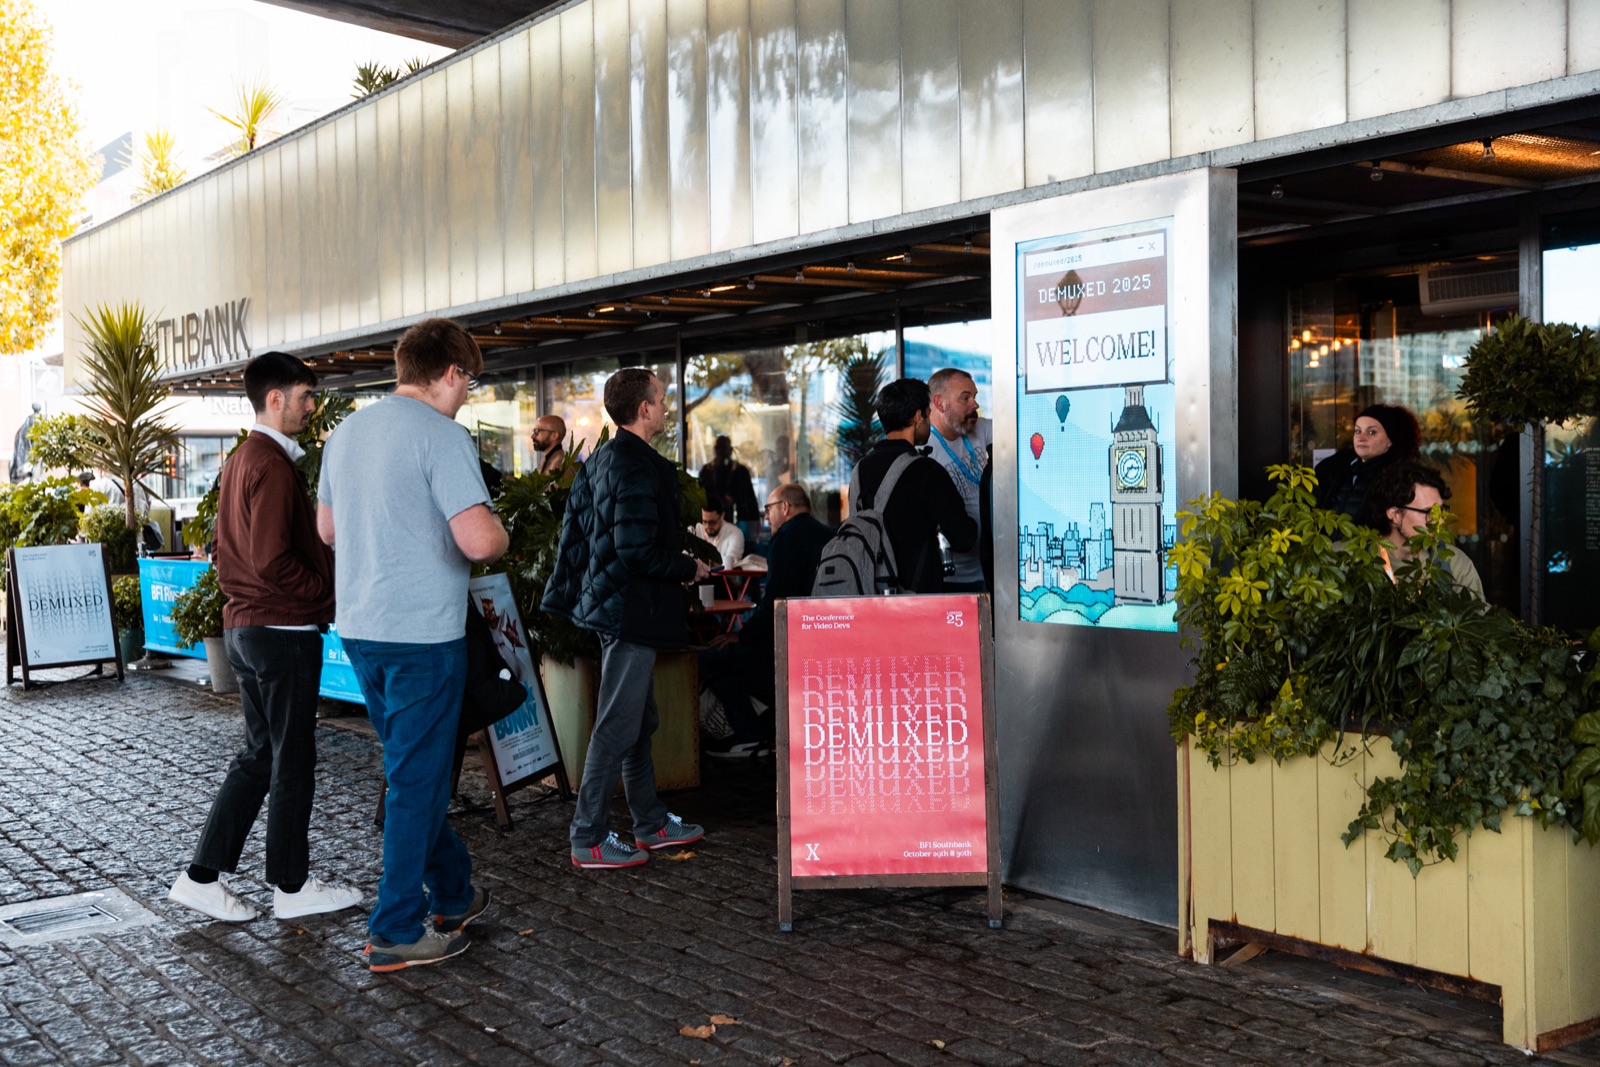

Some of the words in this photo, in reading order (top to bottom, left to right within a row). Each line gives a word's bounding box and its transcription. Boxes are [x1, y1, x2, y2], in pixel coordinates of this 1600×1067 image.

[1038, 281, 1106, 303] DEMUXED
[1112, 273, 1151, 293] 2025
[142, 298, 250, 371] UTHBANK
[1036, 330, 1155, 367] WELCOME!
[29, 594, 103, 611] DEMUXED
[946, 613, 964, 627] 25
[804, 720, 968, 749] DEMUXED
[805, 843, 820, 860] X
